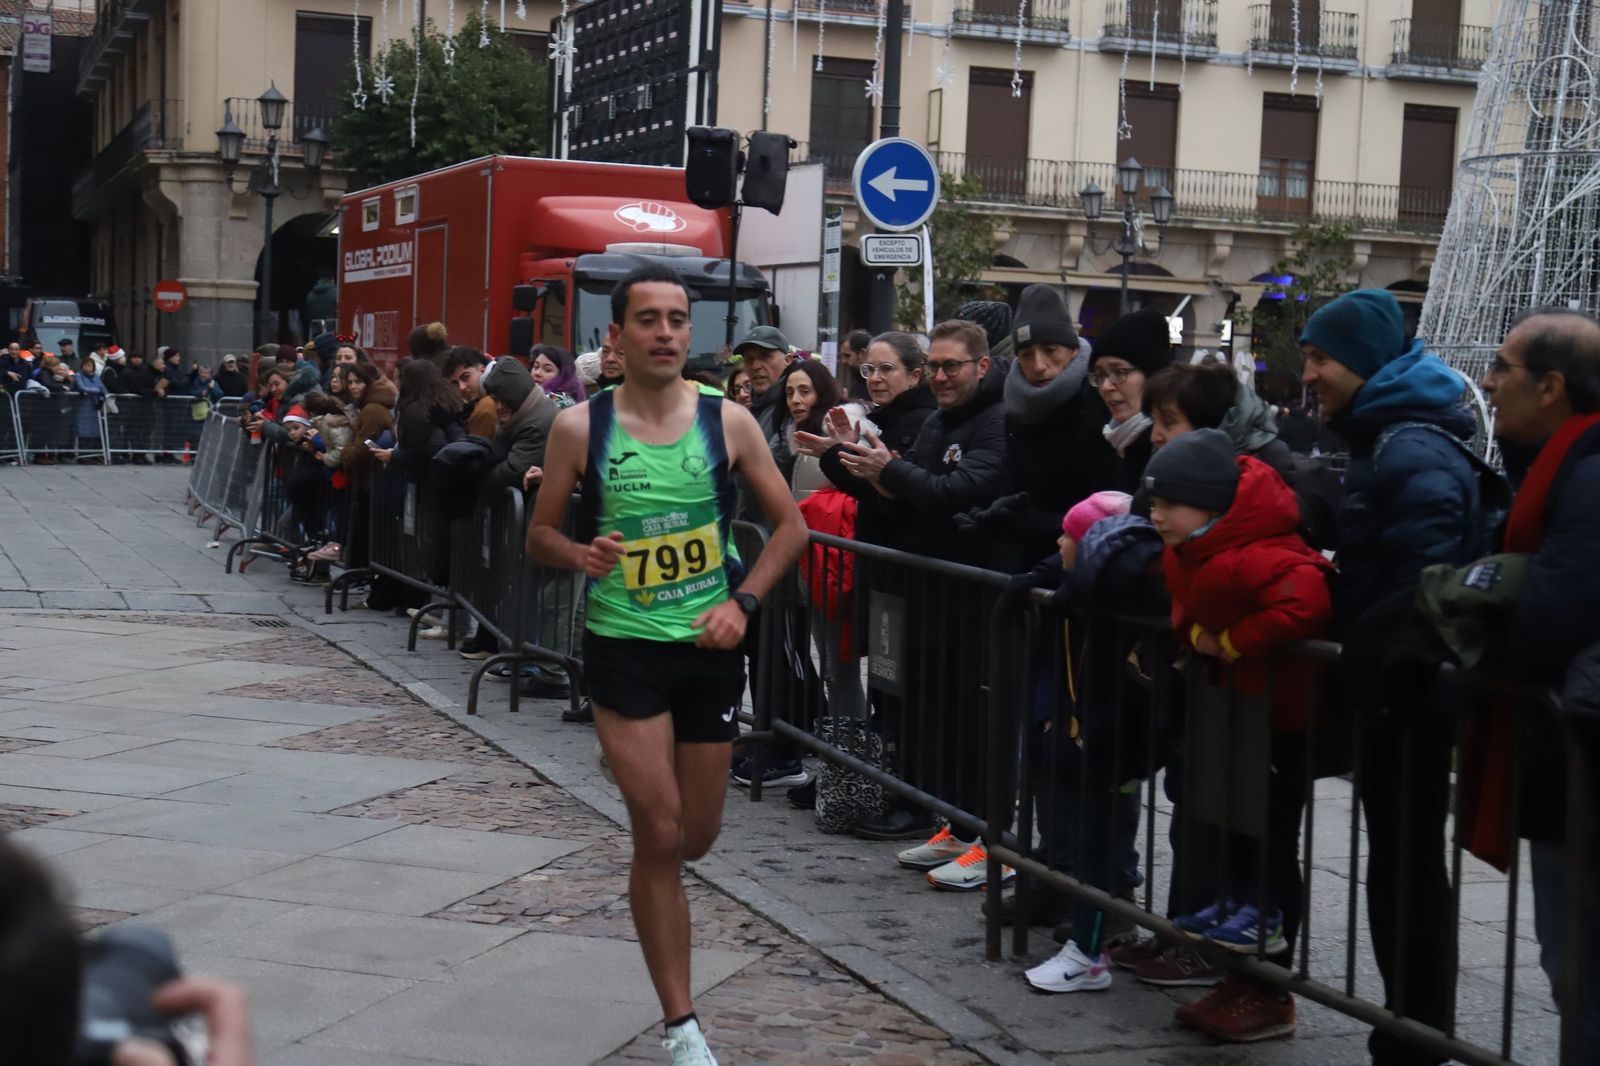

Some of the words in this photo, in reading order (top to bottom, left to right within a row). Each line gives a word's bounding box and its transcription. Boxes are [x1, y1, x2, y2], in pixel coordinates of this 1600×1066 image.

[376, 241, 413, 267] PODIUM
[614, 482, 651, 492] UCLM
[626, 538, 707, 587] 799
[657, 589, 684, 601] CAJA
[685, 576, 719, 595] RURAL
